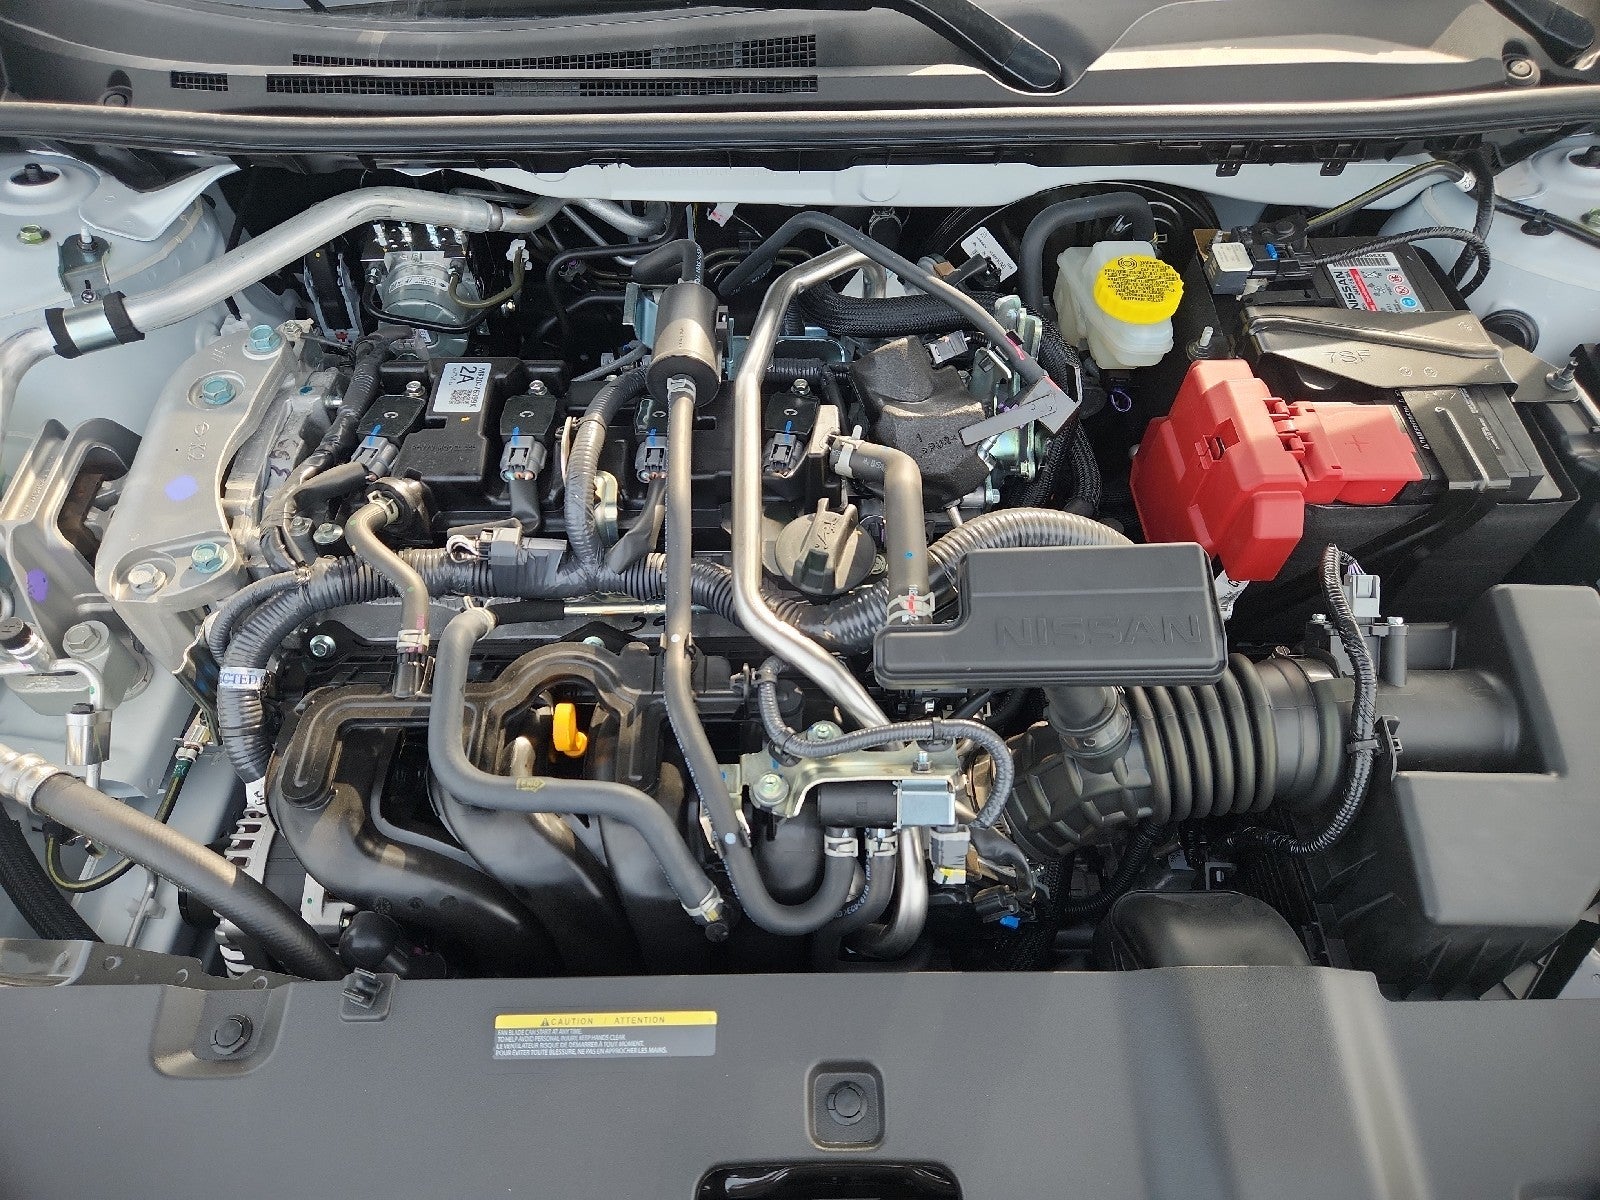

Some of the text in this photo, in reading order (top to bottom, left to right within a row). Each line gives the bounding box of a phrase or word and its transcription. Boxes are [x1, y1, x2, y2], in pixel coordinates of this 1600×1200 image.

[1334, 271, 1361, 311] NISSAN
[456, 365, 478, 385] 2A
[995, 613, 1203, 647] NISSAN
[551, 1018, 593, 1026] CAUTION
[614, 1016, 665, 1025] ATTENTION
